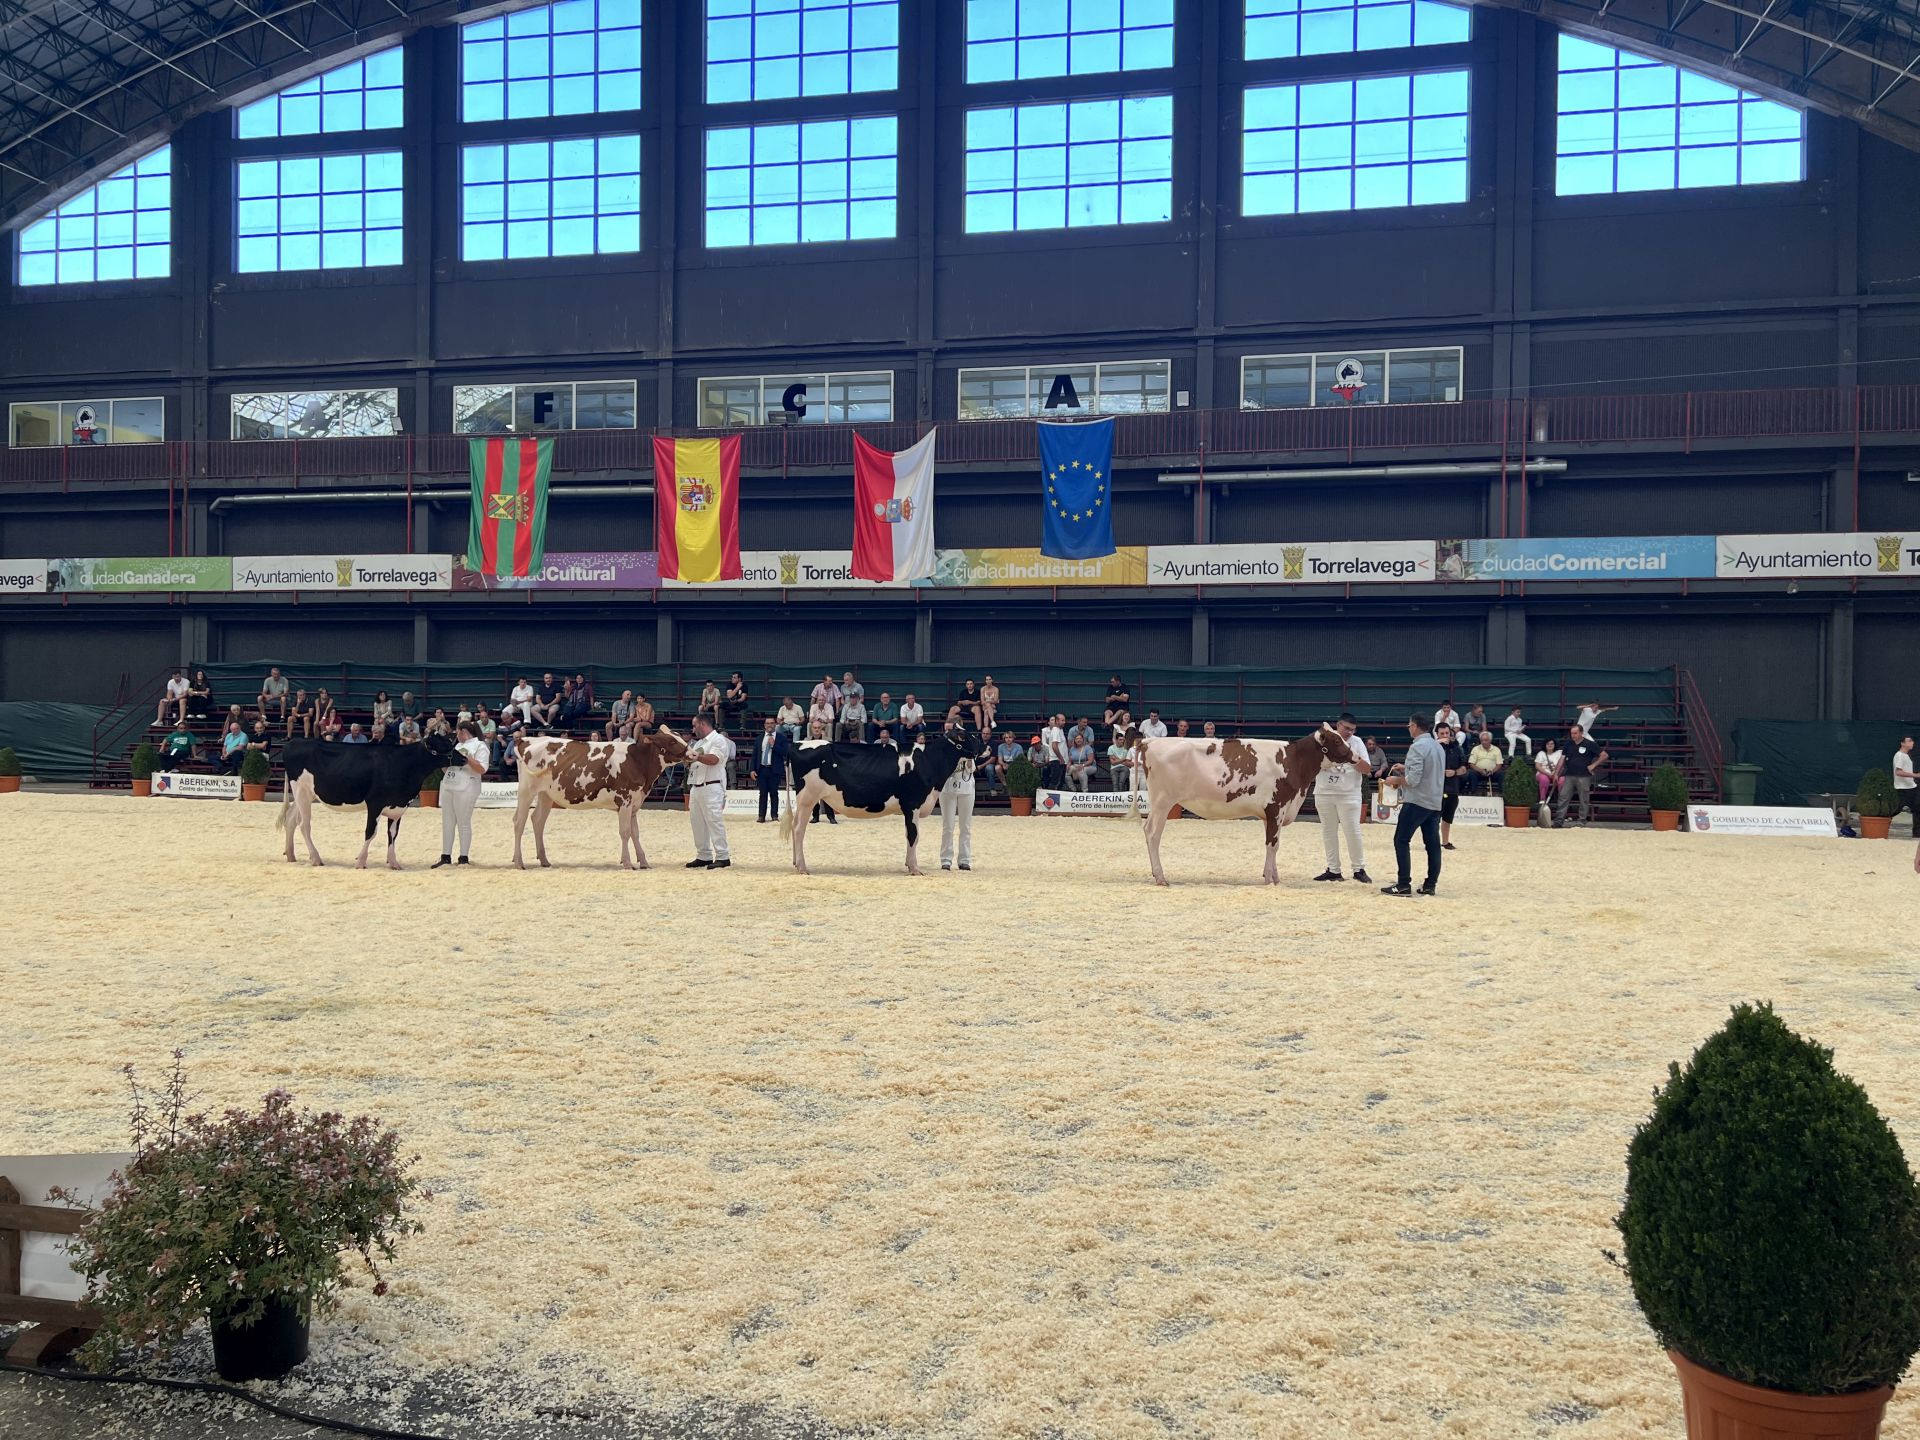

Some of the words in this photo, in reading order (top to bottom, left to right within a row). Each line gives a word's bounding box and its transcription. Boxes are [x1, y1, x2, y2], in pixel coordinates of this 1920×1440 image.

[782, 383, 807, 418] C
[1044, 374, 1081, 409] A
[300, 400, 329, 431] A
[533, 392, 554, 424] F
[1163, 560, 1279, 581] Ayuntamiento
[1308, 557, 1416, 577] Torrelavega
[1482, 552, 1667, 573] ciudadComercial
[1735, 550, 1872, 573] Ayuntamiento
[80, 569, 196, 585] ciudadGanadera
[245, 570, 334, 587] Ayuntamiento
[356, 568, 437, 586] Torrelavega
[953, 562, 1103, 580] ciudadIndustrial
[179, 778, 220, 788] ABEREKIN,
[952, 781, 962, 789] 61
[1328, 775, 1340, 784] 57
[1071, 794, 1125, 803] ABEREKIN,
[1127, 794, 1147, 803] SA.
[1456, 807, 1499, 815] ANTABRIA
[1711, 816, 1760, 824] GOBIERNO
[1775, 817, 1830, 826] CANTABRIA
